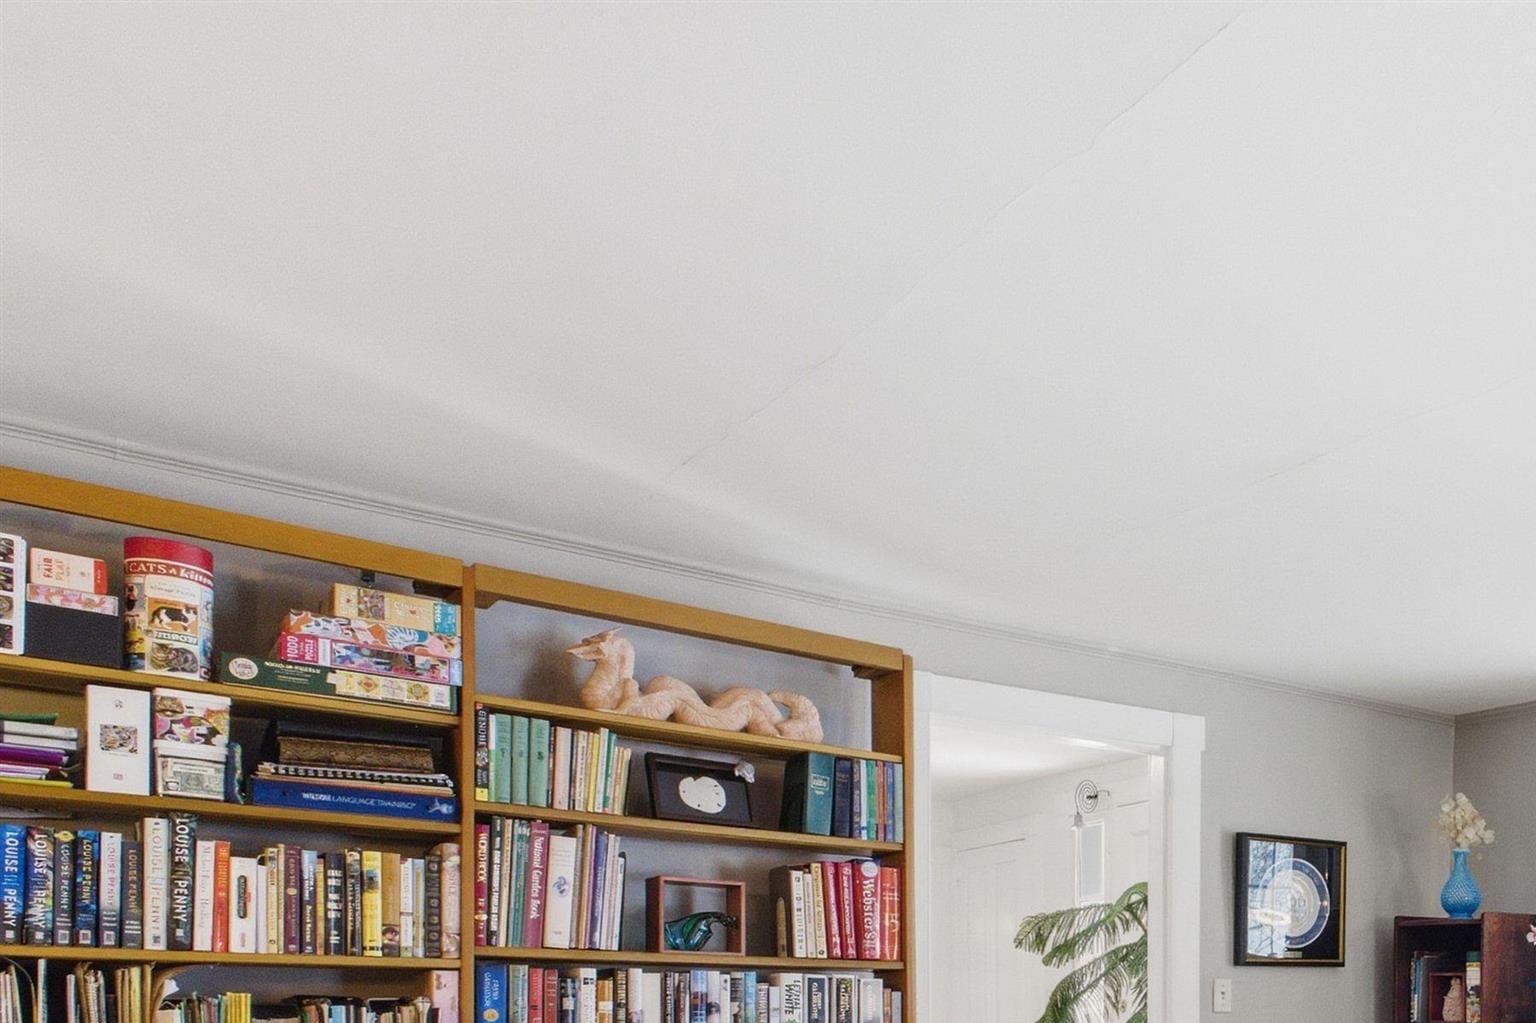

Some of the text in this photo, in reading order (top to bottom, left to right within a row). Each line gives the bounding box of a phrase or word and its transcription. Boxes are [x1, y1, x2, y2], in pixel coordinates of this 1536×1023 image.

[129, 562, 168, 574] CATS
[286, 635, 299, 657] 1000
[3, 832, 19, 927] LOUISE PENNY
[60, 844, 70, 910] LOUISE PENNY
[82, 839, 92, 872] LOUISE
[173, 818, 189, 922] LOUISE PENNY
[529, 836, 545, 920] National Garden Book
[33, 834, 48, 928] LOUISE PENNY
[784, 984, 794, 1015] WHITE
[793, 980, 801, 1010] LETHAL
